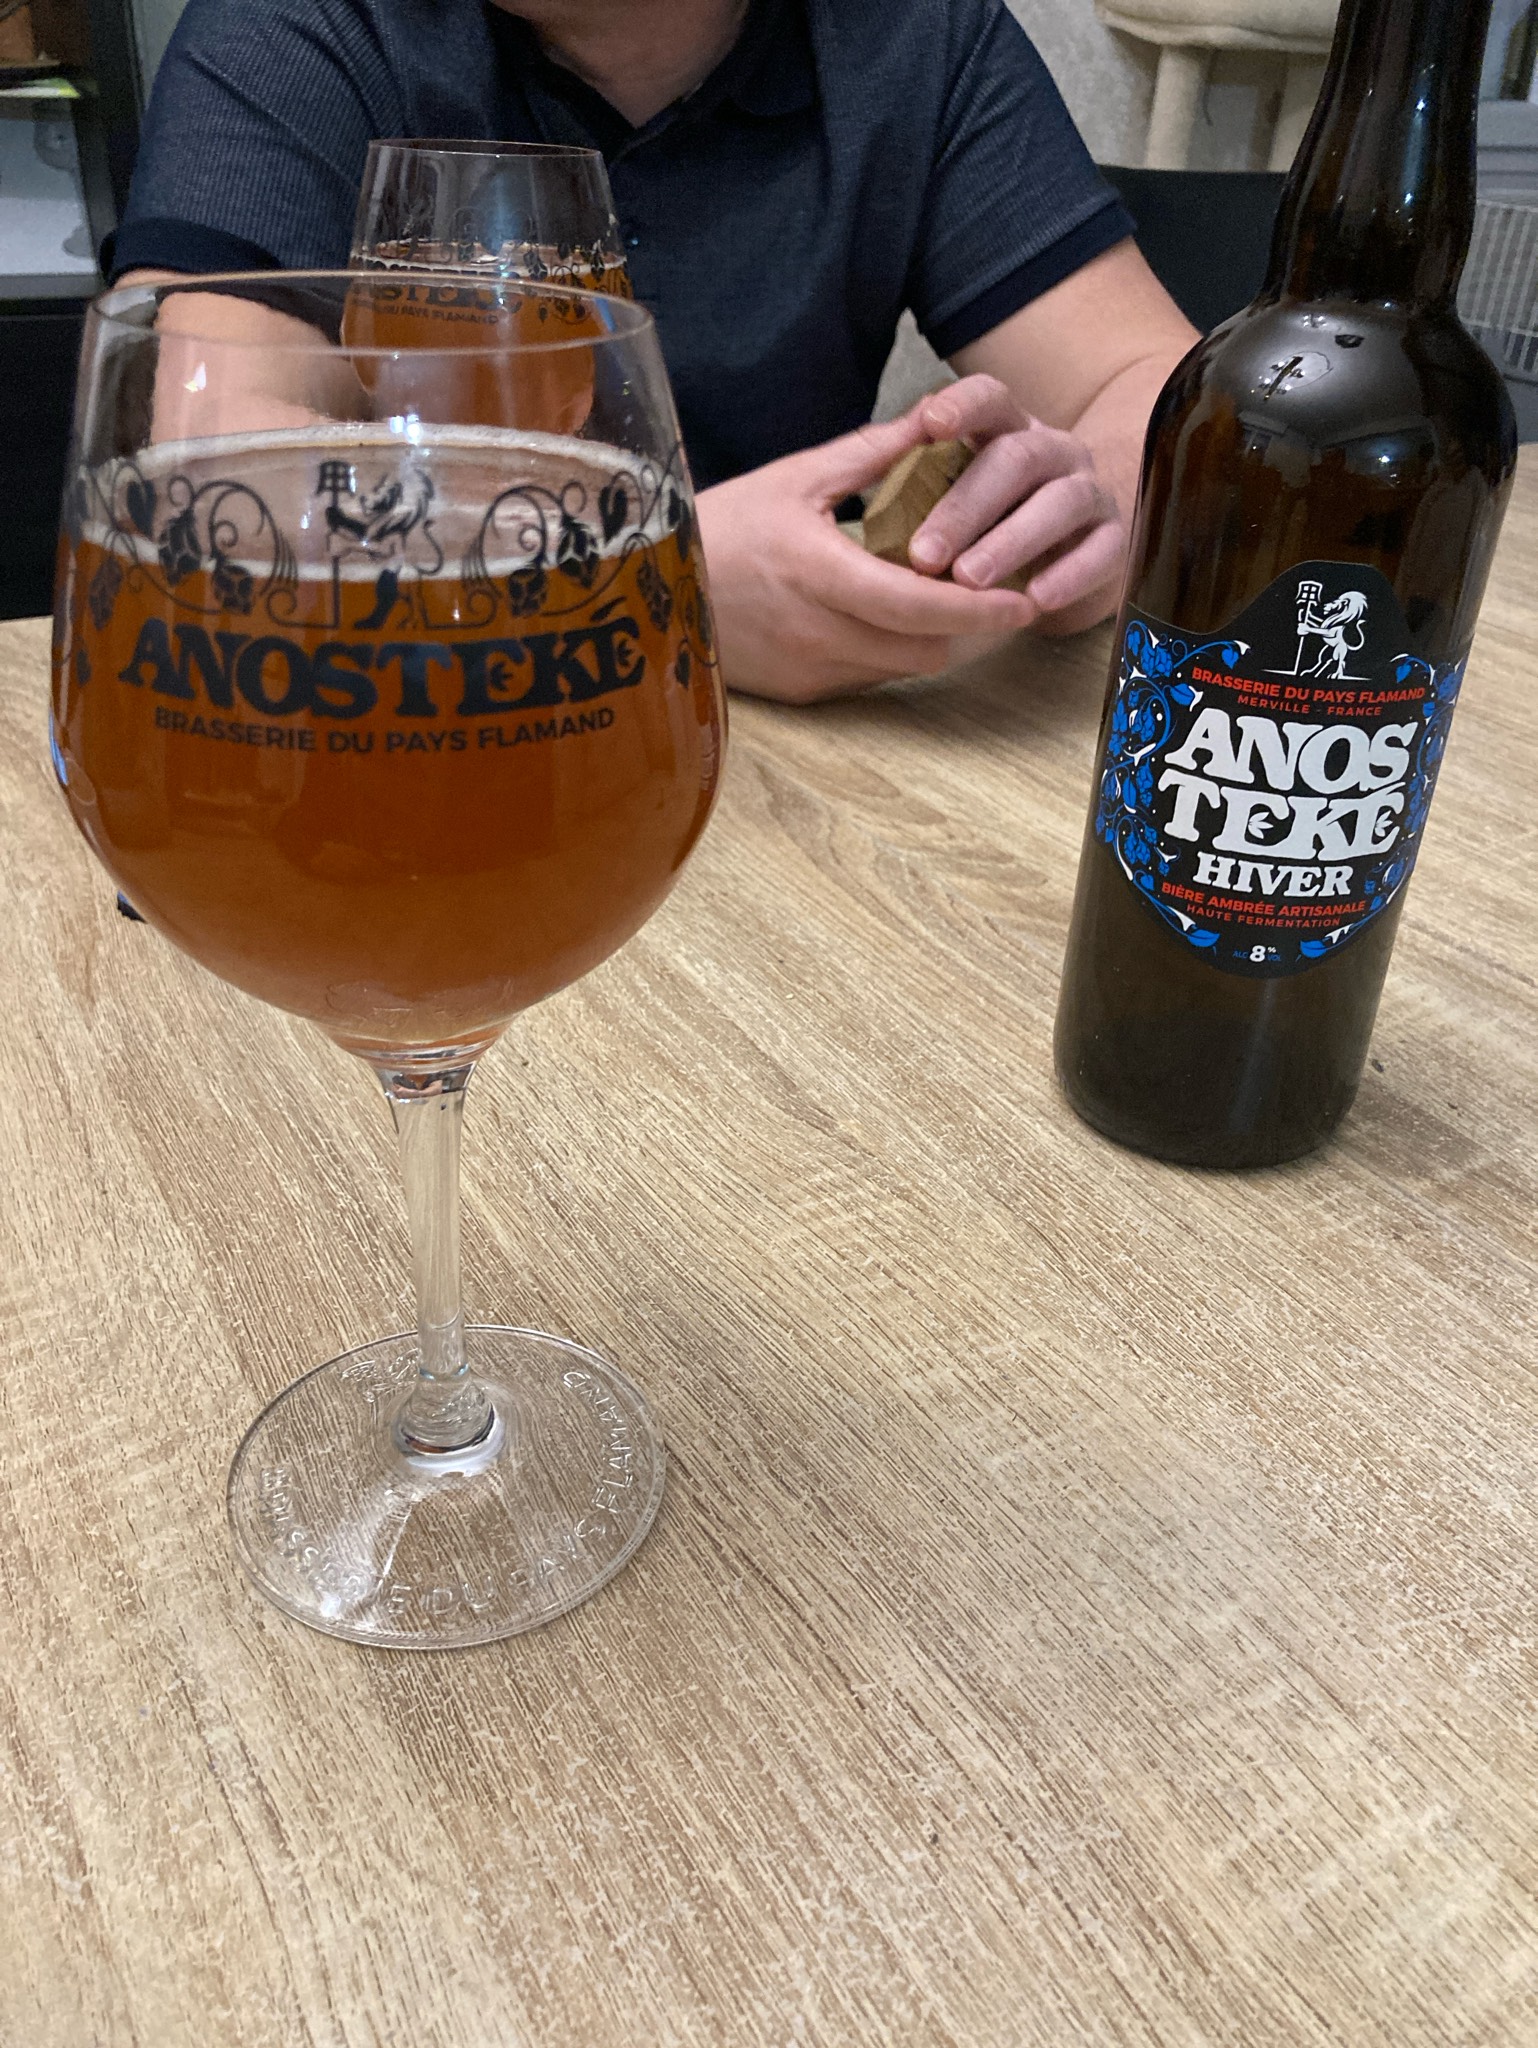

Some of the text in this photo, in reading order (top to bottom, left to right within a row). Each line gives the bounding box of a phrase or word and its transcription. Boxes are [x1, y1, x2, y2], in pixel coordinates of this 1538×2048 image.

[118, 596, 646, 719] ANOSTEKÉ
[1191, 667, 1426, 704] BRASSERIE DU PAYS FLAMAND
[1237, 694, 1310, 714] MERVILLE
[1327, 706, 1382, 716] FRANCE
[155, 706, 615, 754] BRASSERIE DU PAYS FLAMAND
[1165, 708, 1419, 794] ANOS
[1158, 769, 1406, 861] TEKÉ
[1192, 852, 1354, 897] HIVER
[1161, 881, 1366, 916] BIÈRE AMBRÉE ARTISANALE
[1186, 903, 1341, 928] HAUTE FERMENTATION
